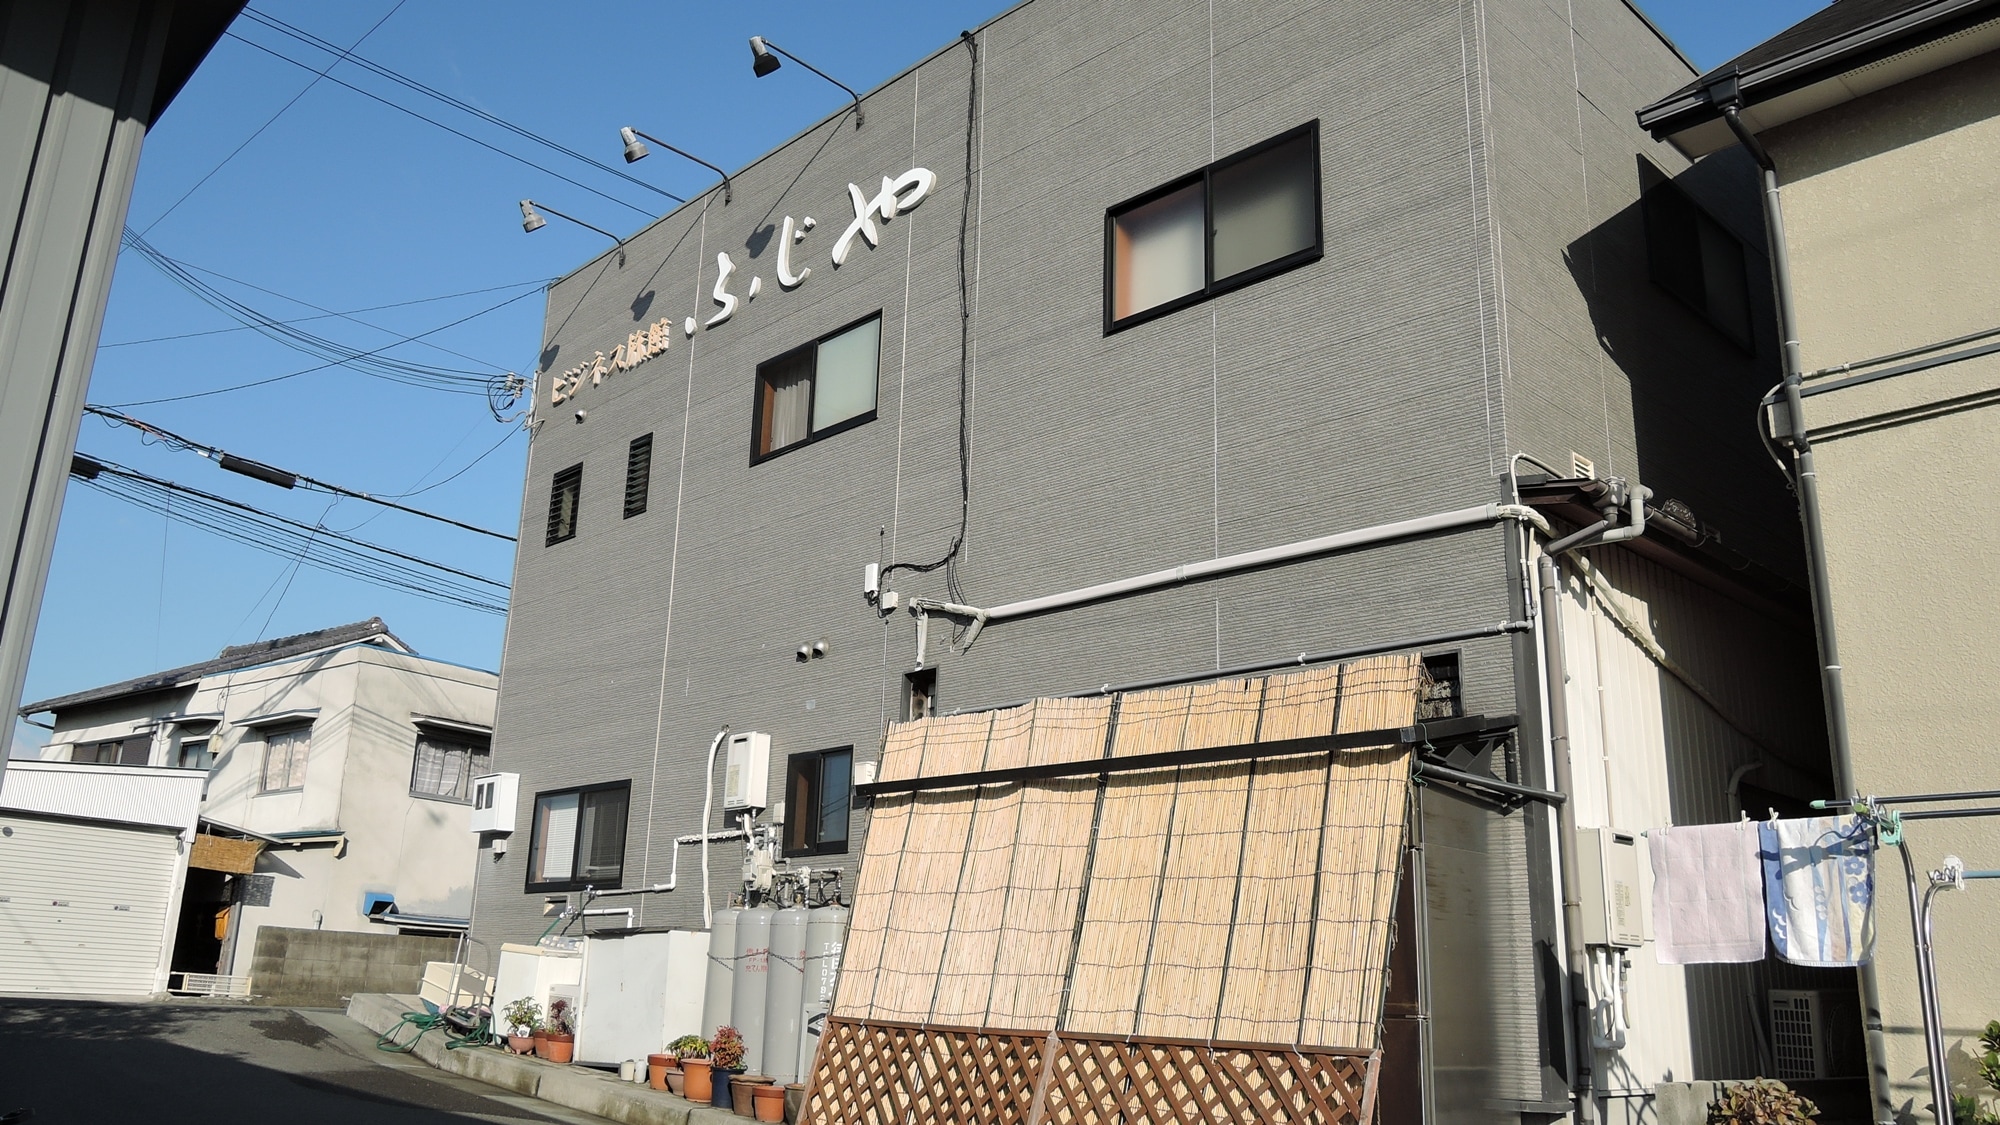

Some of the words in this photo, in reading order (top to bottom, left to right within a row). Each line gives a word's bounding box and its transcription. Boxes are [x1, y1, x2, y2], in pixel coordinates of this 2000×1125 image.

[684, 167, 937, 336] ふじや
[552, 317, 672, 402] ビジネス旅館
